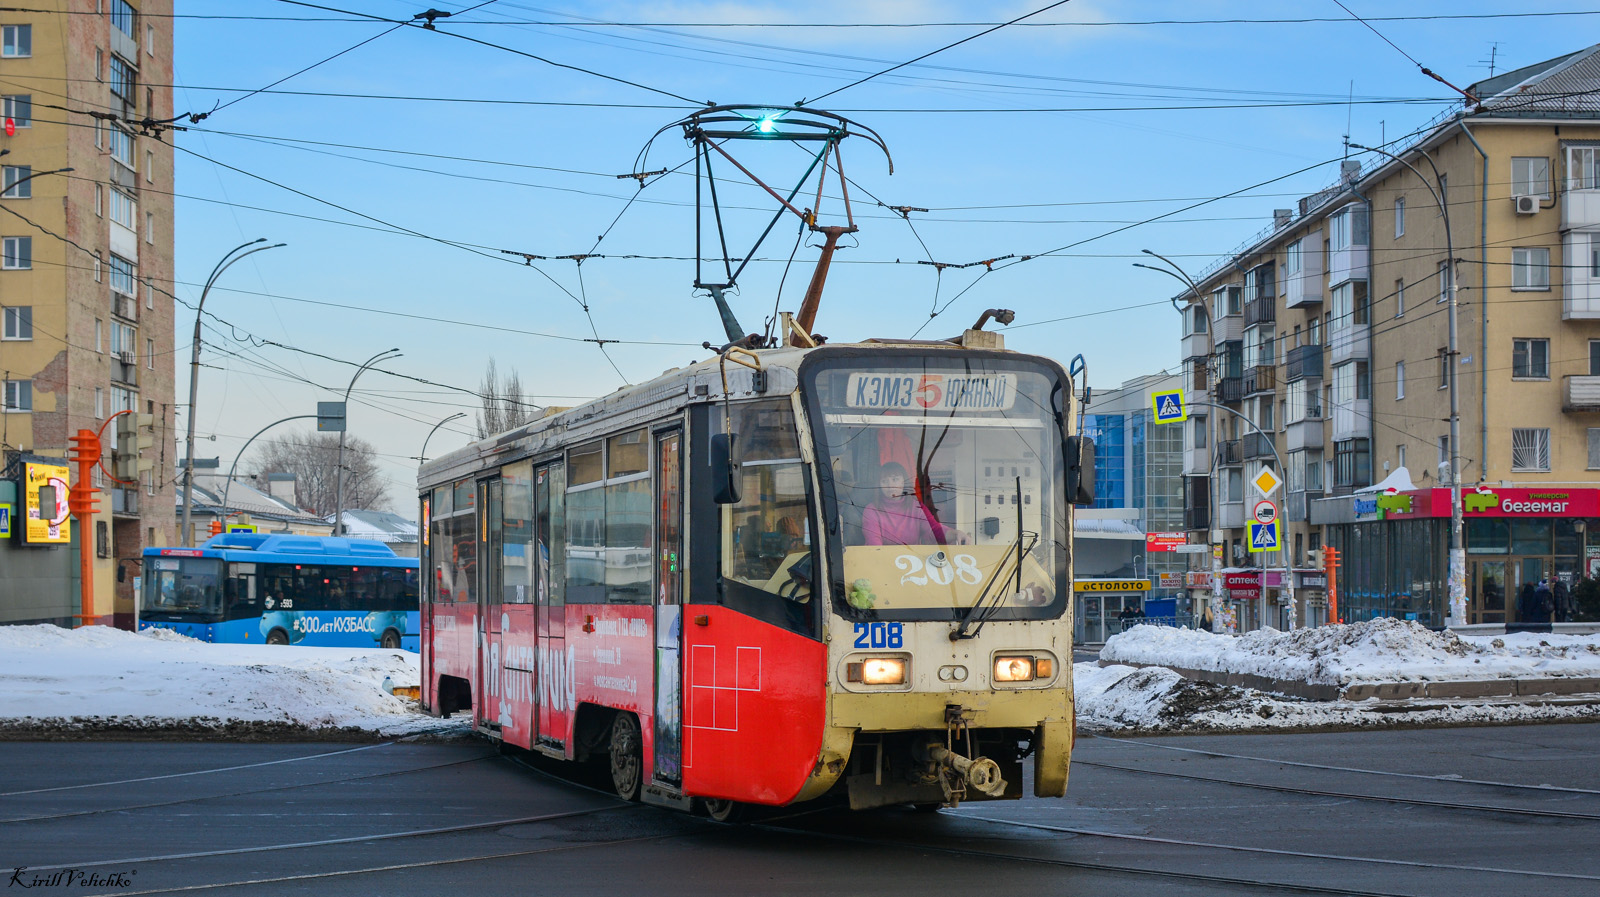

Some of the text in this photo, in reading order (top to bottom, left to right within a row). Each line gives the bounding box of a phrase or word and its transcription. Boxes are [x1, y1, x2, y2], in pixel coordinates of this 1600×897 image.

[855, 375, 1007, 408] КЭМЗ 5 ЮЖНЫЙ
[1502, 499, 1569, 513] бегемаг
[895, 554, 982, 586] 208
[1090, 582, 1144, 590] СТОЛОТО
[853, 622, 903, 649] 208
